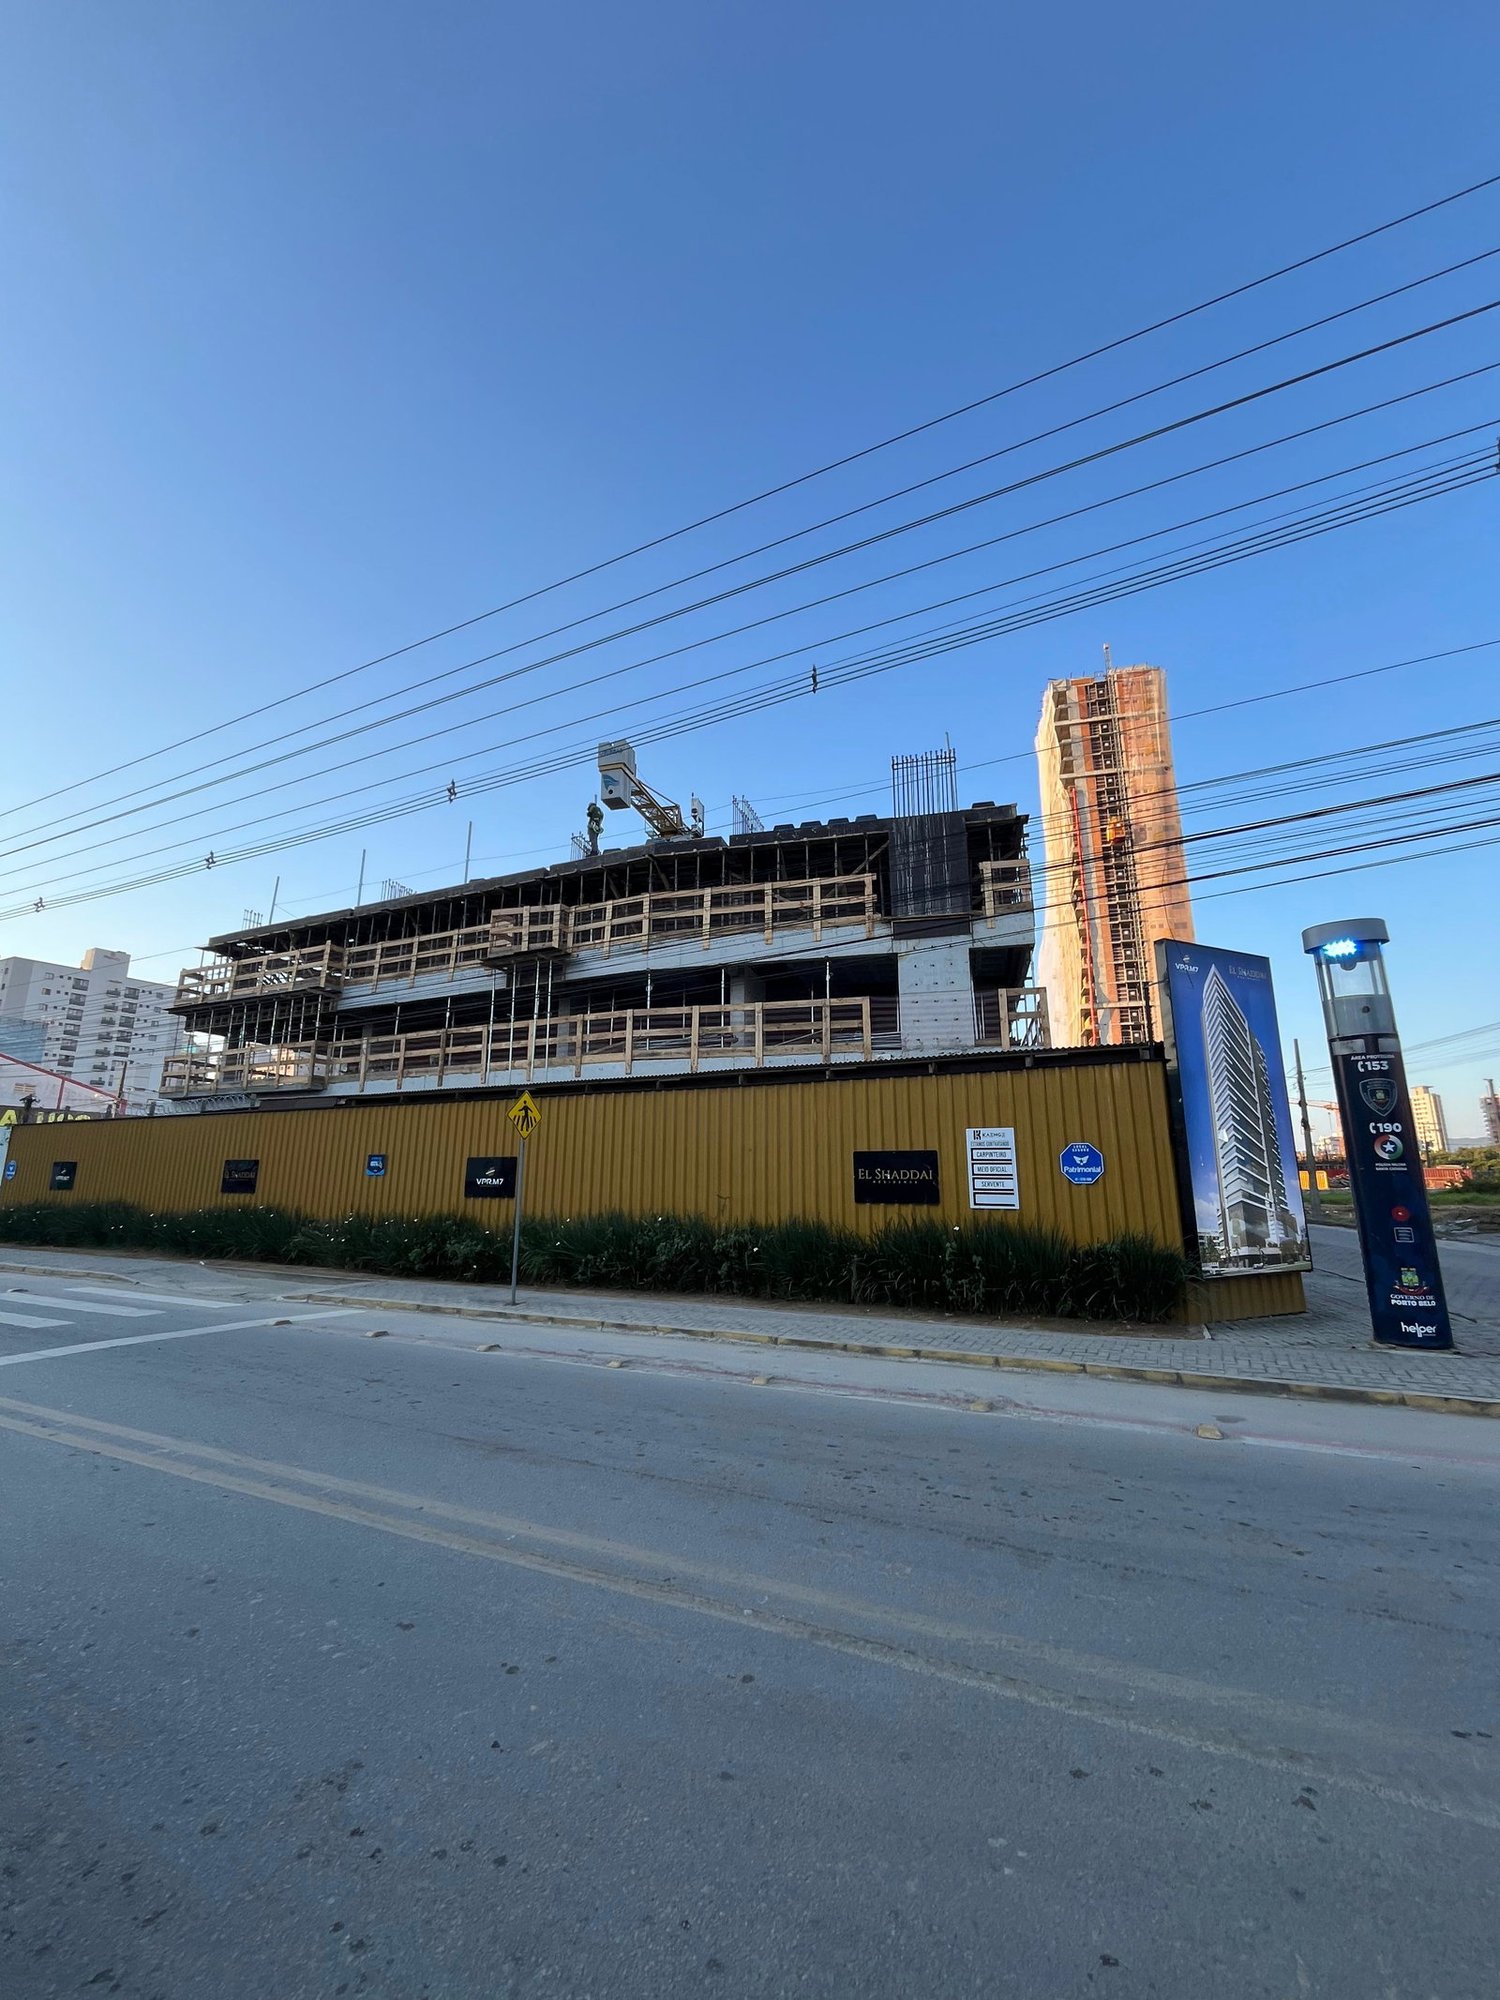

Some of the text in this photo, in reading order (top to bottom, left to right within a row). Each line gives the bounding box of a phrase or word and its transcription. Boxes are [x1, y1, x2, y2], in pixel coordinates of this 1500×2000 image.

[1365, 1061, 1389, 1071] 153
[1377, 1122, 1403, 1133] 190
[858, 1168, 933, 1180] EL SHADDAI
[1400, 1321, 1437, 1337] helper
